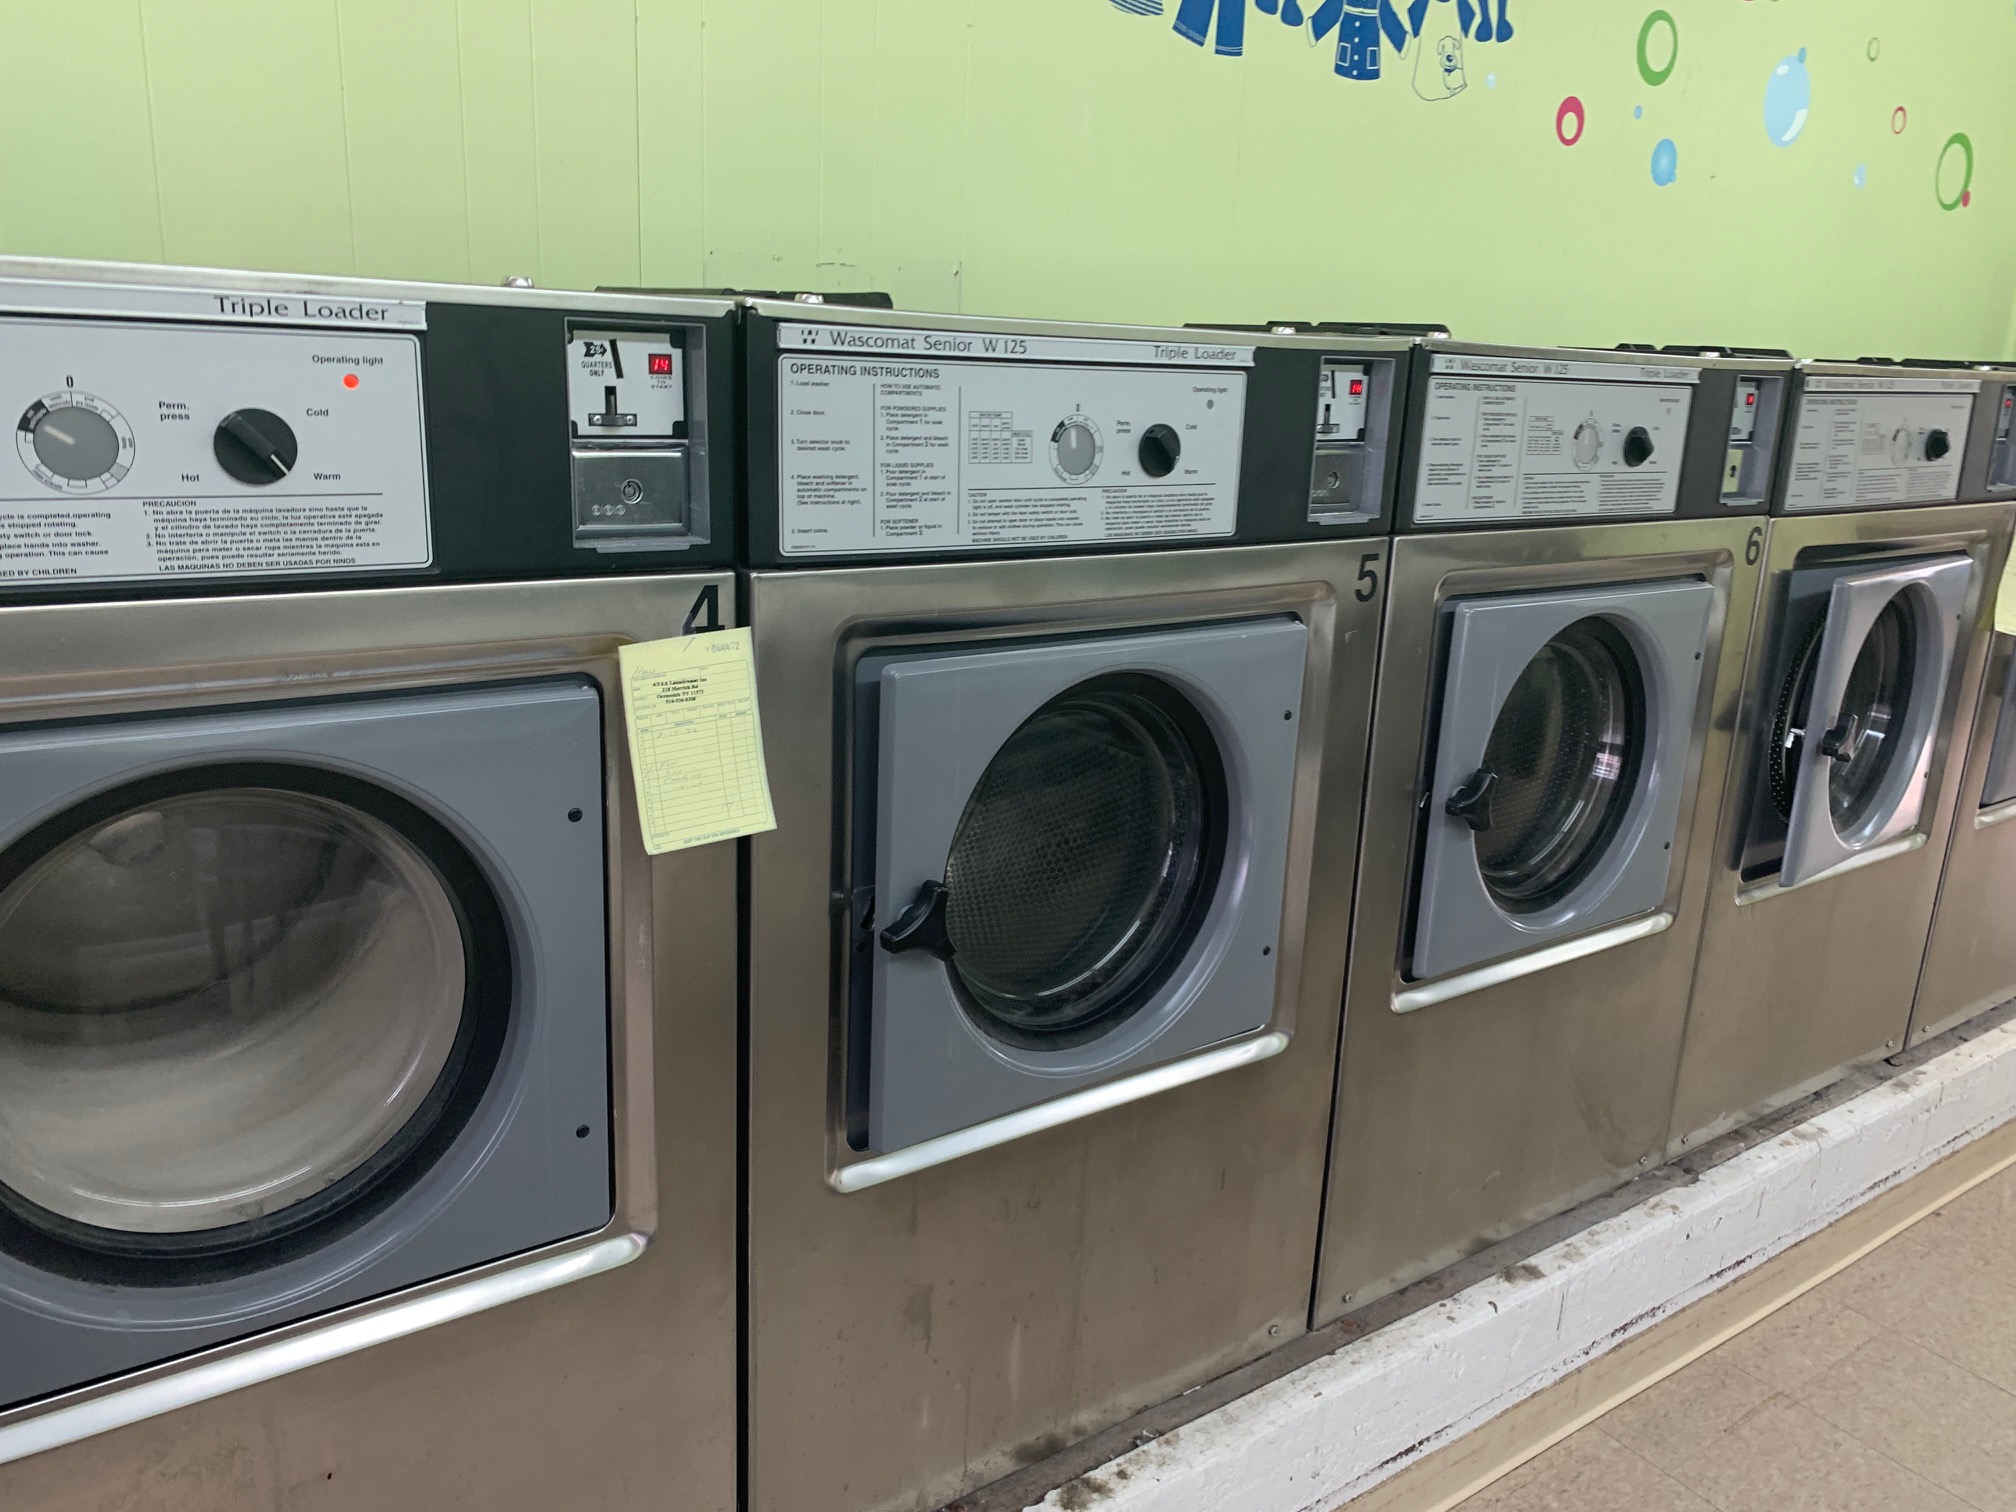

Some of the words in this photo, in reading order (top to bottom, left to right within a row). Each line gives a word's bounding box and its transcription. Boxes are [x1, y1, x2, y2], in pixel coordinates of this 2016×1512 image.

[214, 295, 288, 317] Triple
[304, 300, 388, 321] Loader
[830, 330, 916, 350] Wascomat
[923, 335, 972, 353] Senior
[982, 338, 998, 353] W
[1004, 339, 1027, 354] 125
[1153, 344, 1188, 360] Triple
[1194, 347, 1236, 360] Loader
[312, 355, 360, 365] Operating
[362, 356, 383, 366] light
[581, 361, 613, 369] QUARTERS
[790, 363, 857, 376] OPERATING
[860, 365, 940, 379] INSTRUCTIONS
[1460, 360, 1508, 372] Wascomat
[1511, 361, 1539, 373] Senior
[589, 369, 604, 377] ONLY
[66, 375, 74, 389] 0
[159, 402, 190, 411] Perm.
[160, 412, 190, 421] press
[306, 408, 329, 417] Cold
[181, 474, 200, 482] Hot
[314, 472, 341, 480] Warm
[195, 508, 219, 516] puerta
[260, 521, 315, 529] completamente
[1745, 526, 1763, 566] 6
[178, 563, 220, 571] MAQUINAS
[237, 561, 263, 569] DEBEN
[283, 559, 314, 567] USADAS
[32, 568, 77, 576] CHILDREN
[1354, 553, 1381, 603] 5
[682, 584, 725, 636] 4
[670, 678, 699, 686] Laundromat
